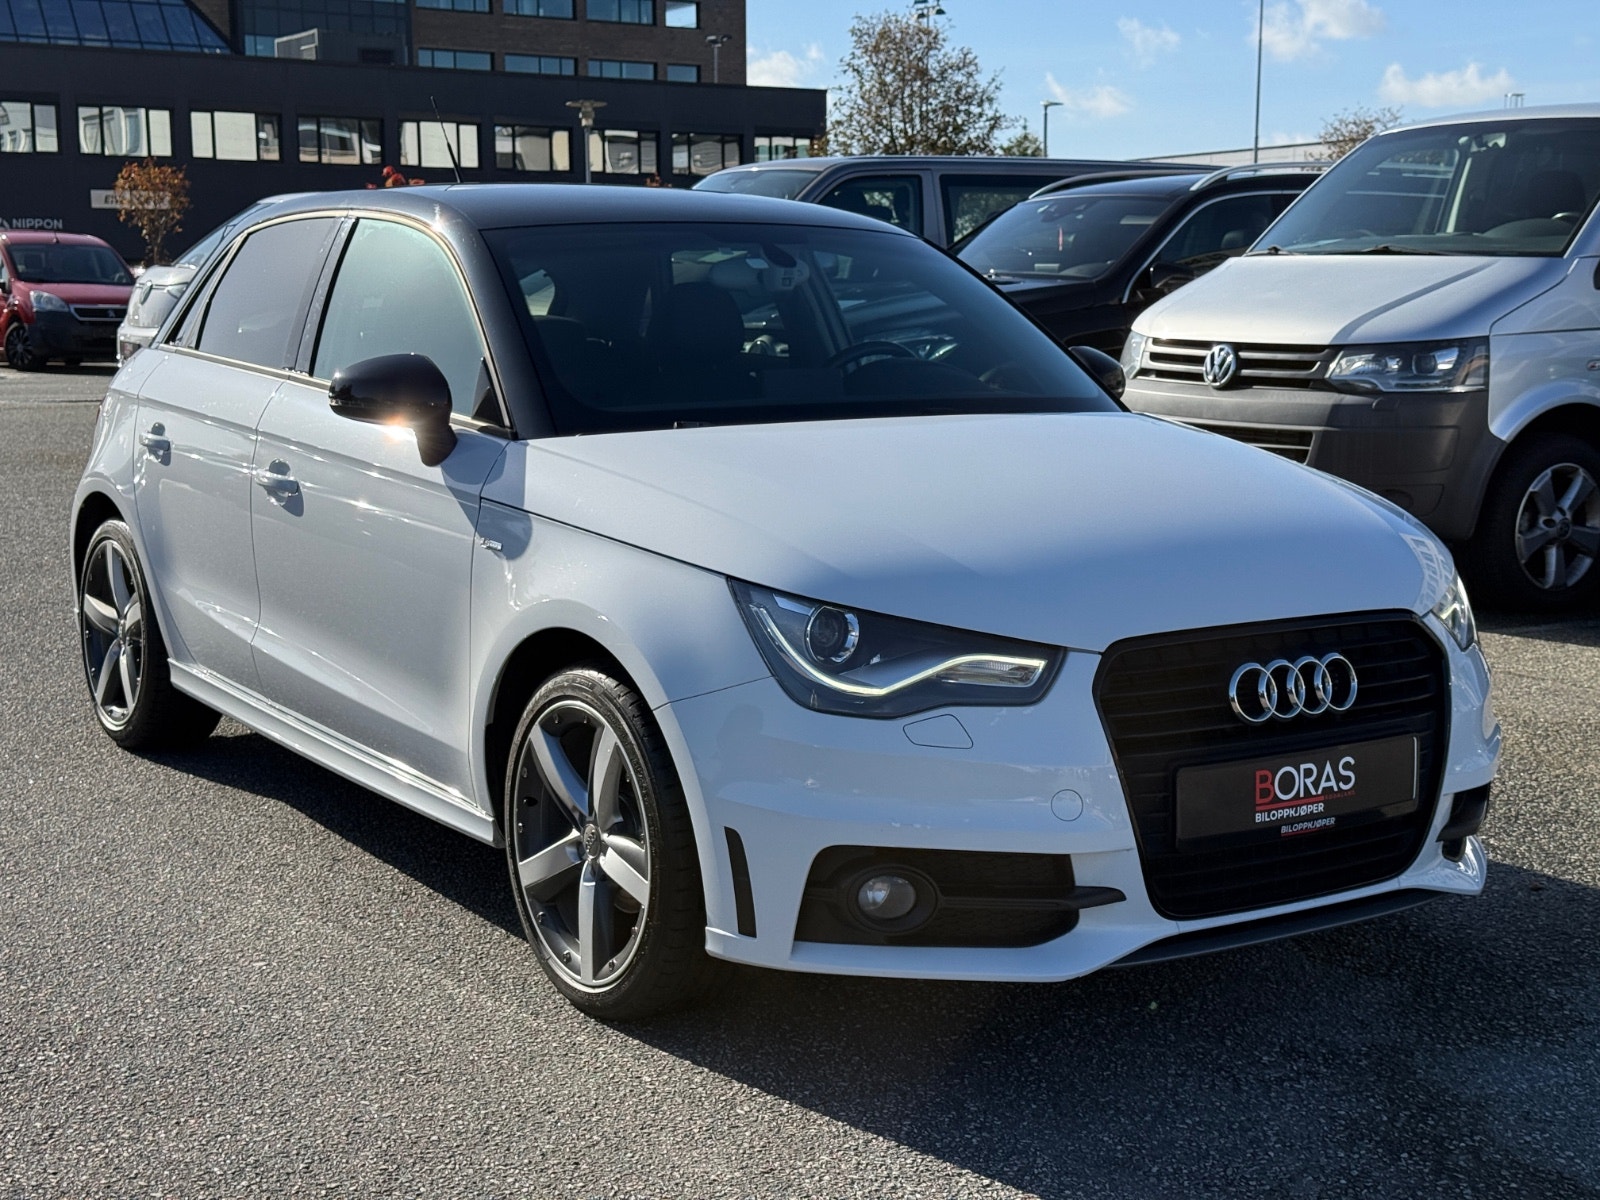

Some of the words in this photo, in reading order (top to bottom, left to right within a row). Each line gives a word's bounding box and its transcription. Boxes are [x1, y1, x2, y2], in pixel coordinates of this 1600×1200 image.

[12, 217, 63, 229] NIPPON
[1254, 756, 1356, 804] BORAS
[1255, 802, 1325, 823] BILOPPKJØPER
[1280, 817, 1336, 834] BILOPPKJØPER
